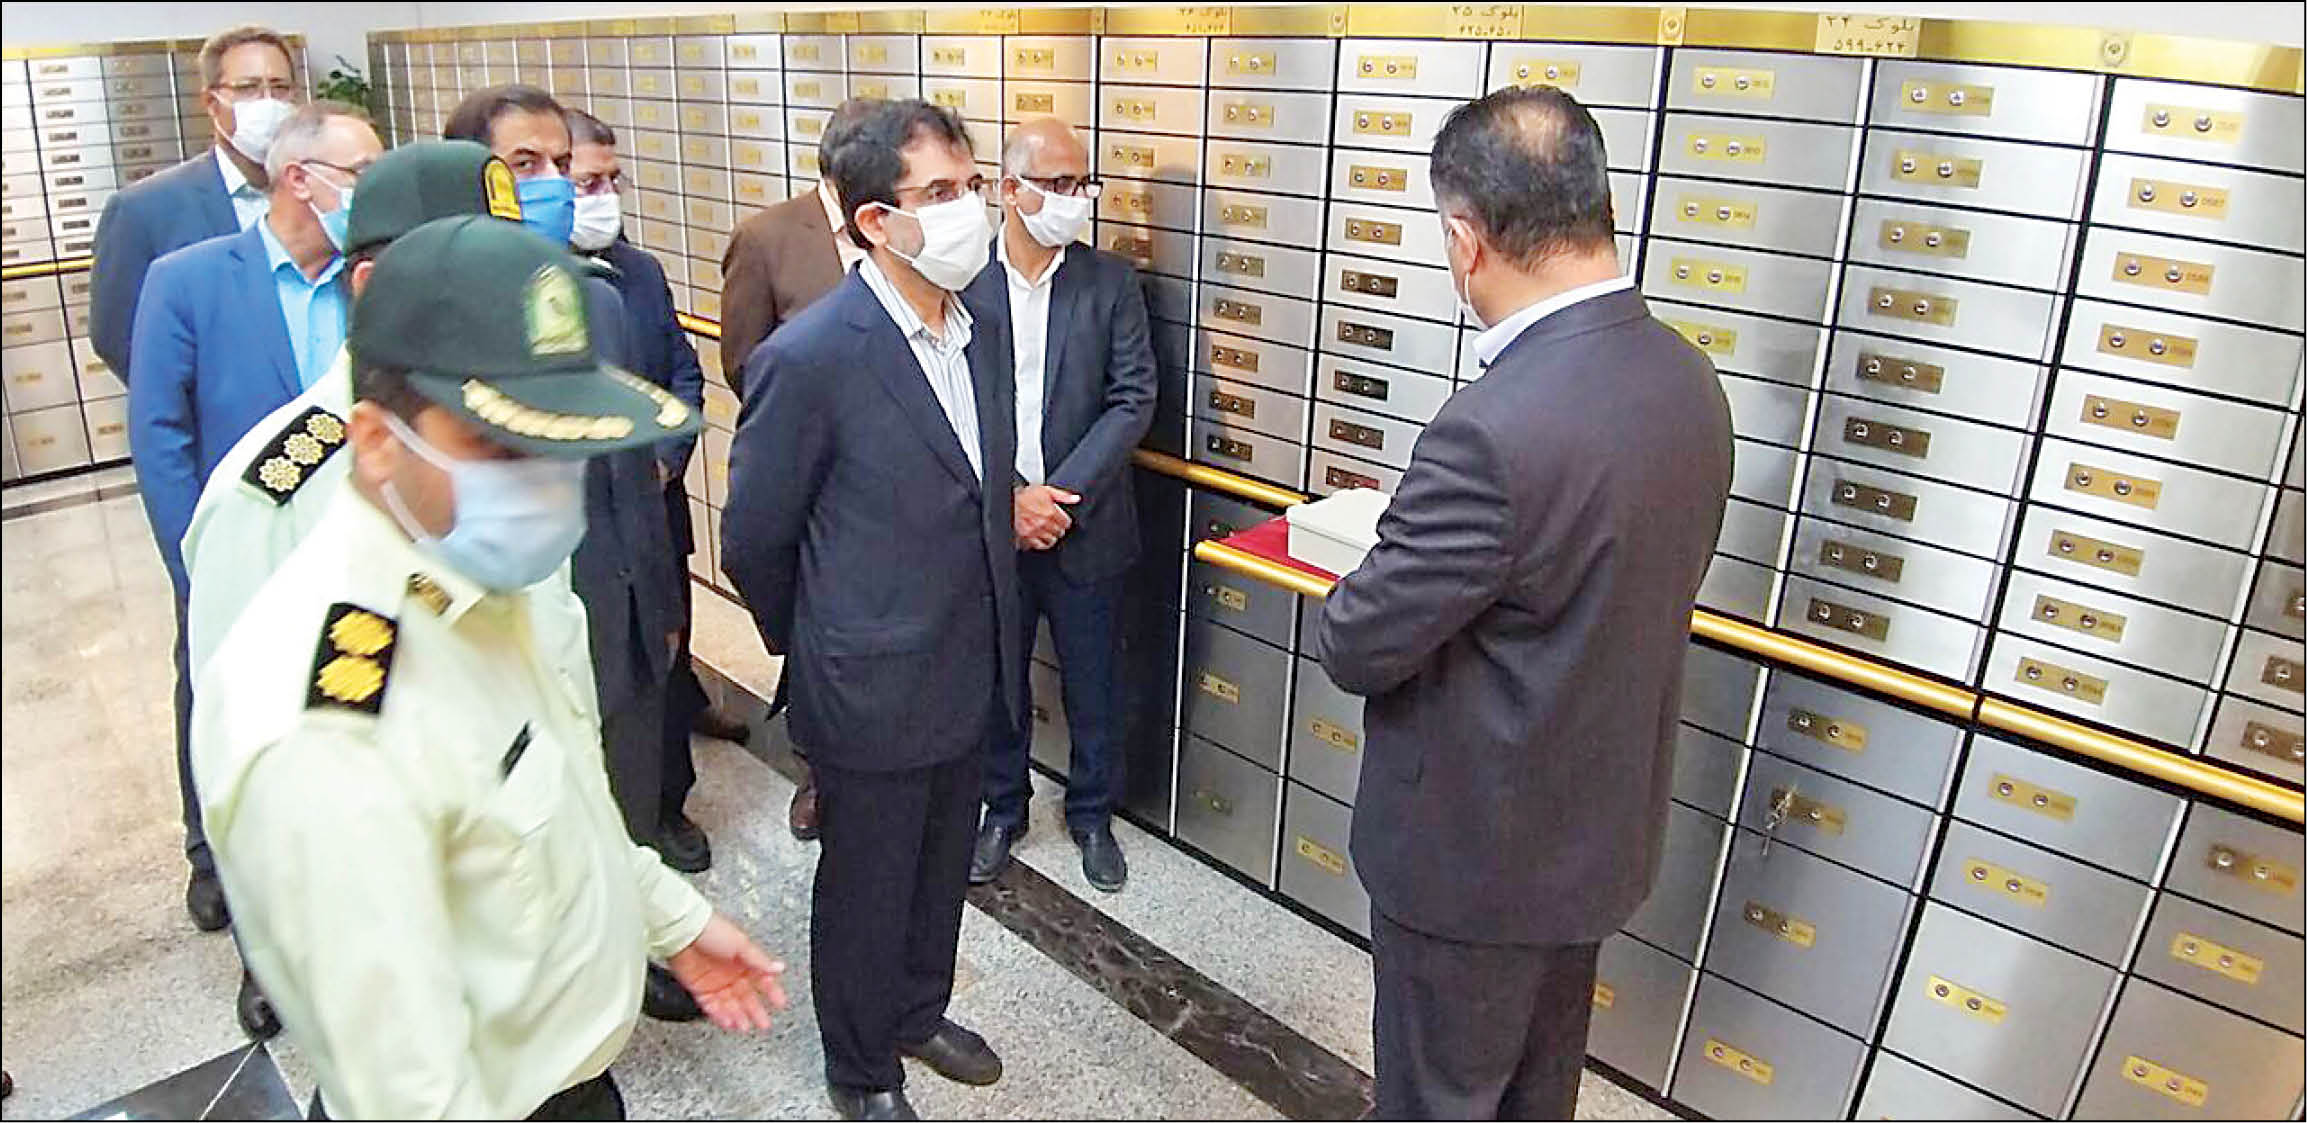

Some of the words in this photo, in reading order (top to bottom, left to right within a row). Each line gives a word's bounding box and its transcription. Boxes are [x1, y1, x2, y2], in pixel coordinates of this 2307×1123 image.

[1452, 6, 1472, 16] ۲۵
[1480, 5, 1518, 20] بلوک
[1863, 16, 1914, 34] بلوک
